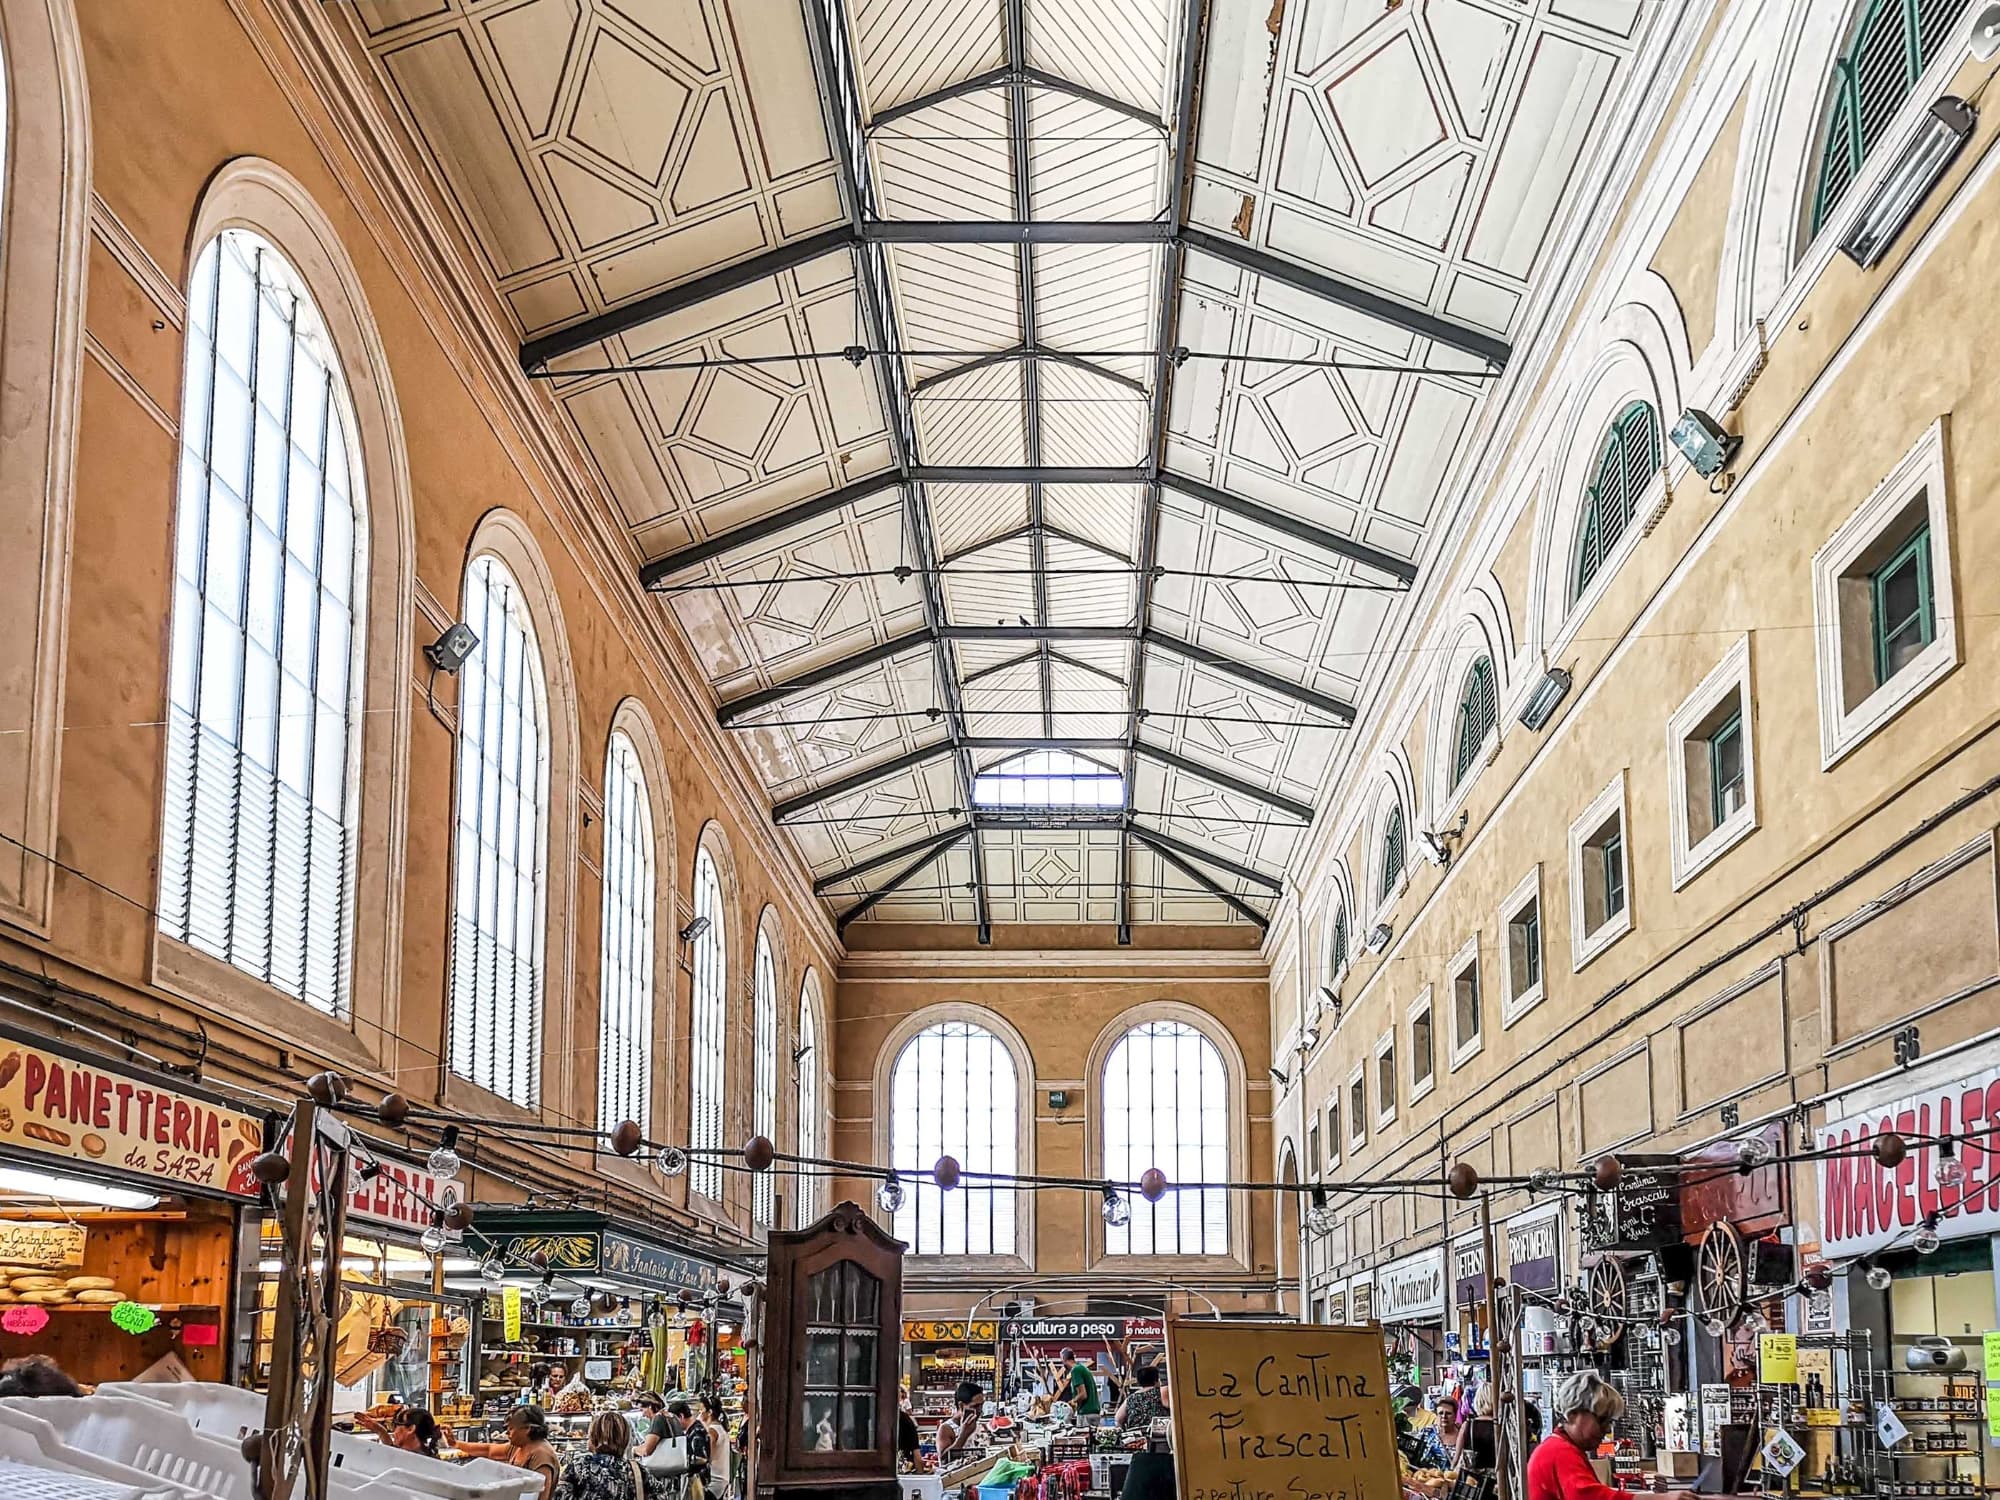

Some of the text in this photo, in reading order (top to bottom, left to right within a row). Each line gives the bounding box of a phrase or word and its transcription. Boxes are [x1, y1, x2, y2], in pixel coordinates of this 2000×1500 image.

[1894, 1025, 1920, 1066] 56
[24, 1053, 220, 1159] PANETTERIA
[124, 1146, 215, 1184] da SARA
[1620, 1189, 1670, 1212] Frascati
[1620, 1217, 1640, 1232] vini
[631, 1246, 667, 1280] Fantasie
[668, 1260, 678, 1281] di
[1509, 1226, 1555, 1266] PROFUMERIA
[1388, 1269, 1432, 1314] Norcineria
[908, 1321, 998, 1340] & DOLCI
[1021, 1321, 1116, 1338] cultura a peso
[1192, 1350, 1242, 1398] La
